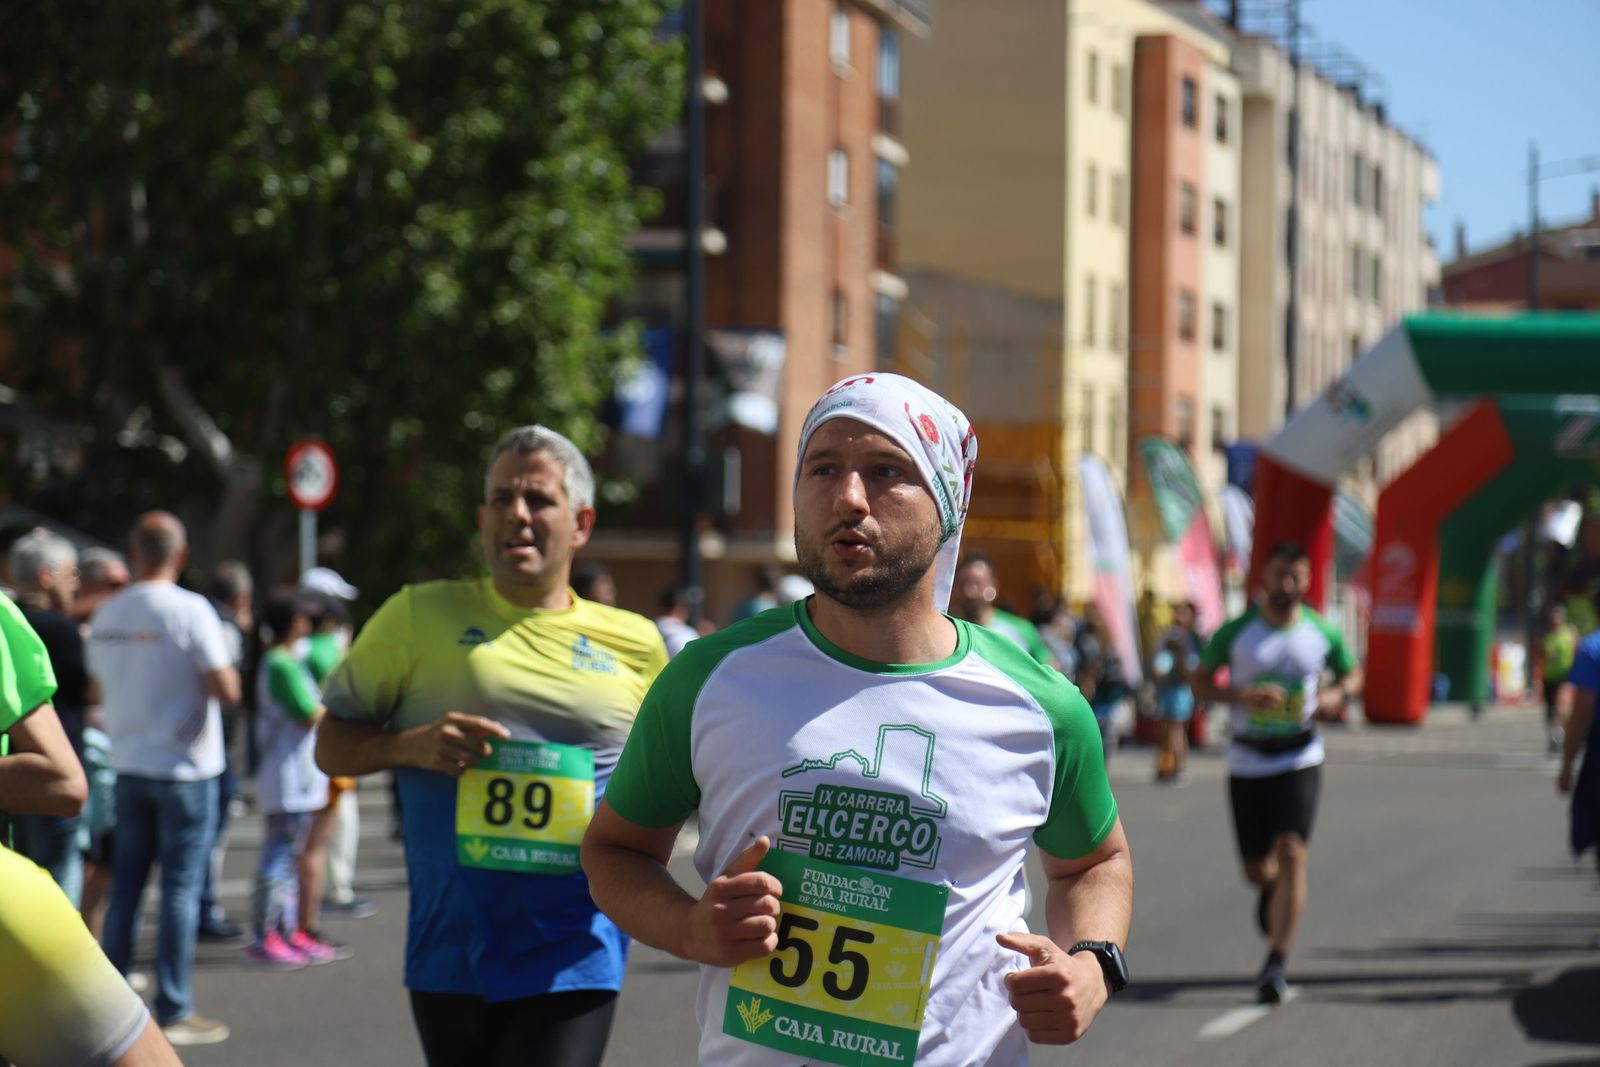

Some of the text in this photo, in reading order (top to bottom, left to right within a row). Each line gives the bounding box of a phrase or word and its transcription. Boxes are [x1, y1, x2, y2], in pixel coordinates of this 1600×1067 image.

[484, 778, 553, 829] 89
[818, 790, 905, 815] IX CARRERA
[788, 805, 931, 850] EL CERCO
[815, 842, 895, 866] DE ZAMORA
[798, 895, 847, 913] DE ZAMORA
[800, 881, 889, 912] CAJA RURAL
[769, 912, 875, 1001] 55
[774, 1016, 905, 1061] CAJA RURAL
